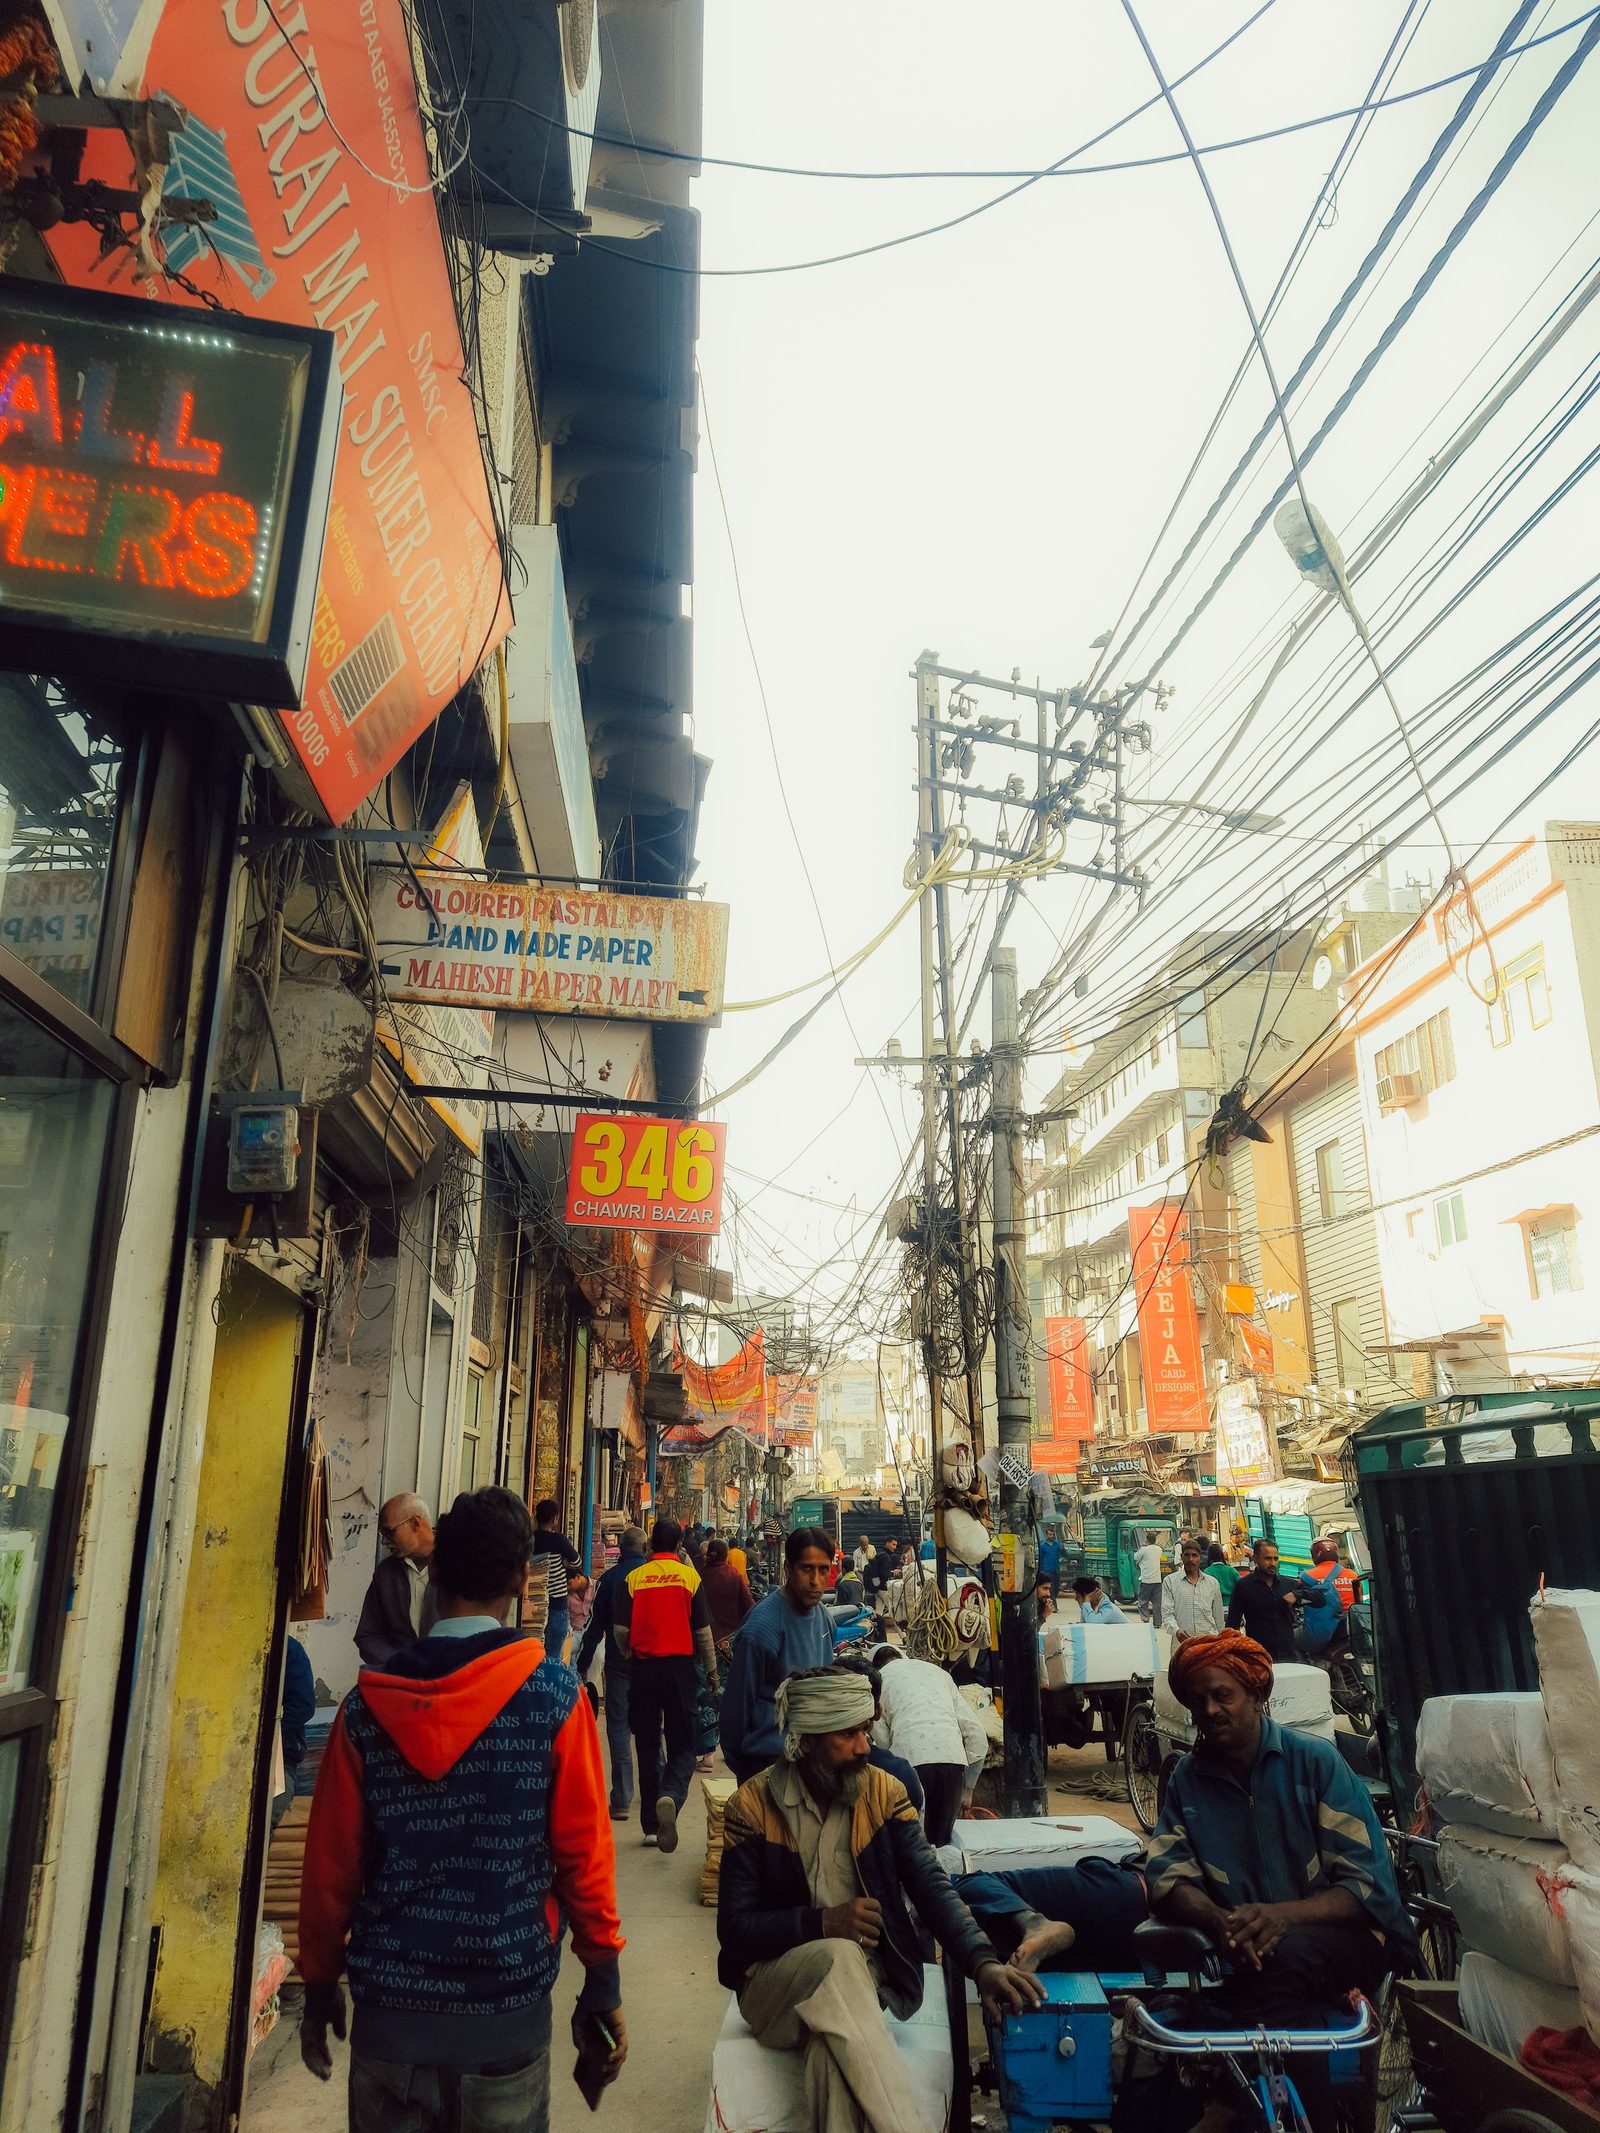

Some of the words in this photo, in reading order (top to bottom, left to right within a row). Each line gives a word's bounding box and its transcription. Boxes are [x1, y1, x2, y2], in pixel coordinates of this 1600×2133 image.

[408, 331, 448, 436] SMSC
[348, 384, 432, 577] SUMER
[400, 557, 463, 697] CHAND
[396, 886, 524, 920] COLOURED
[532, 899, 621, 928] PASTAL
[428, 921, 498, 952] HAND
[503, 929, 570, 957] MADE
[576, 936, 653, 966] PAPER
[404, 958, 514, 996] MAHESH
[522, 970, 603, 1002] PAPER
[609, 976, 677, 1009] MART
[580, 1121, 717, 1203] 346
[573, 1200, 647, 1220] CHAWRI
[651, 1206, 715, 1225] BAZAR
[1151, 1217, 1182, 1365] SUNEJA
[1061, 1325, 1078, 1404] SUNEJA
[1161, 1368, 1186, 1379] CARD
[1154, 1382, 1195, 1392] DESIGNS
[1010, 1466, 1028, 1487] CASH
[644, 1574, 682, 1584] DHL
[475, 1739, 536, 1751] ARMANI
[493, 1761, 542, 1774] JEANS
[398, 1781, 449, 1798] JEANS
[378, 1798, 437, 1817] ARMANI
[440, 1792, 487, 1810] JEANS
[404, 1813, 466, 1832] ARMANI
[470, 1813, 512, 1826] JEANS
[472, 1836, 524, 1850] ARMANI
[429, 1856, 482, 1873] ARMANI
[484, 1857, 523, 1872] JEANS
[438, 1888, 476, 1903] JEANS
[400, 1905, 455, 1922] ARMANI
[455, 1911, 500, 1926] JEANS
[504, 1896, 539, 1918] JEANS
[453, 1932, 512, 1949] ARMANI
[377, 1959, 425, 1975] JEANS
[499, 1956, 550, 1981] ARMANI
[413, 1979, 467, 1995] JEANS
[379, 1995, 440, 2013] ARMANI
[443, 2001, 495, 2015] JEANS
